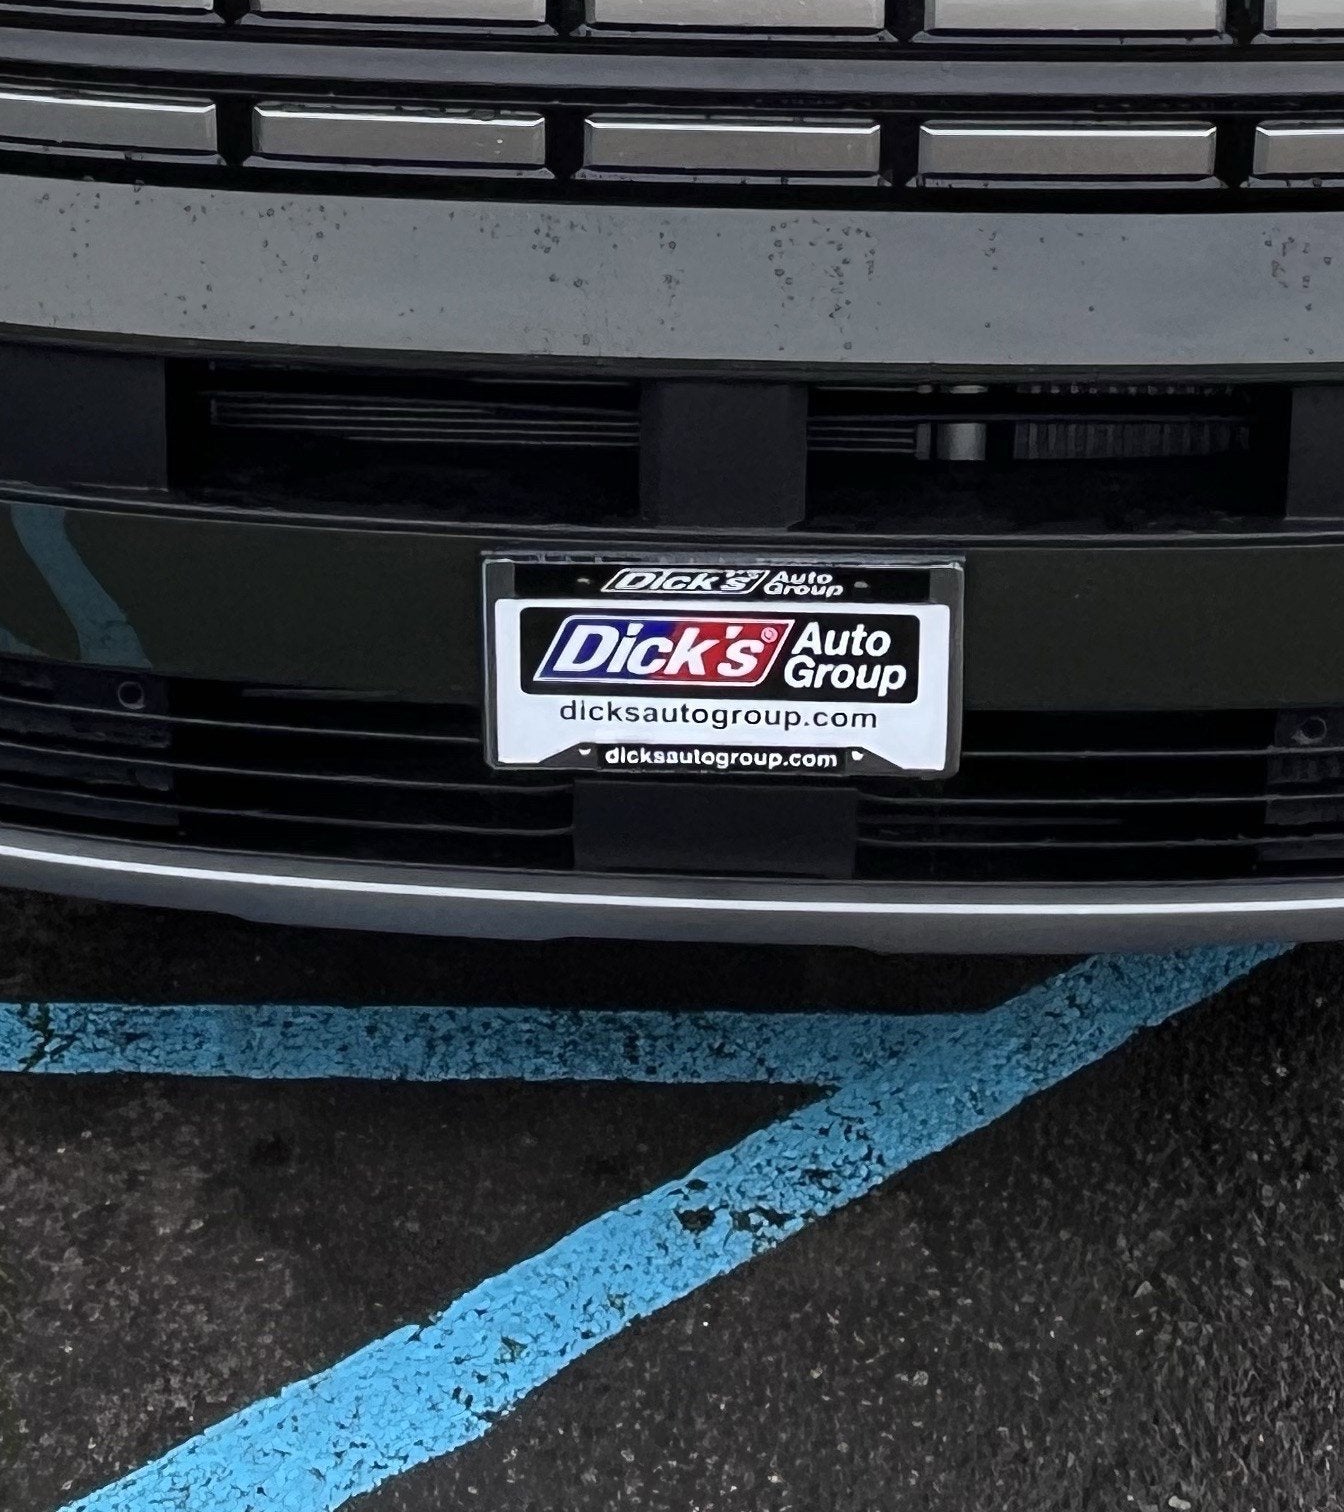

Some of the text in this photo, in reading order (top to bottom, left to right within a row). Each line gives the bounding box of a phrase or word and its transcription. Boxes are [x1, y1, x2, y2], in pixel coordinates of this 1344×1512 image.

[763, 582, 844, 598] Group
[769, 570, 834, 585] Auto
[552, 621, 892, 678] Dick's Auto
[783, 654, 907, 698] Group
[559, 700, 878, 731] dicksautogroup.com
[605, 747, 838, 769] dicksautogroup.com
